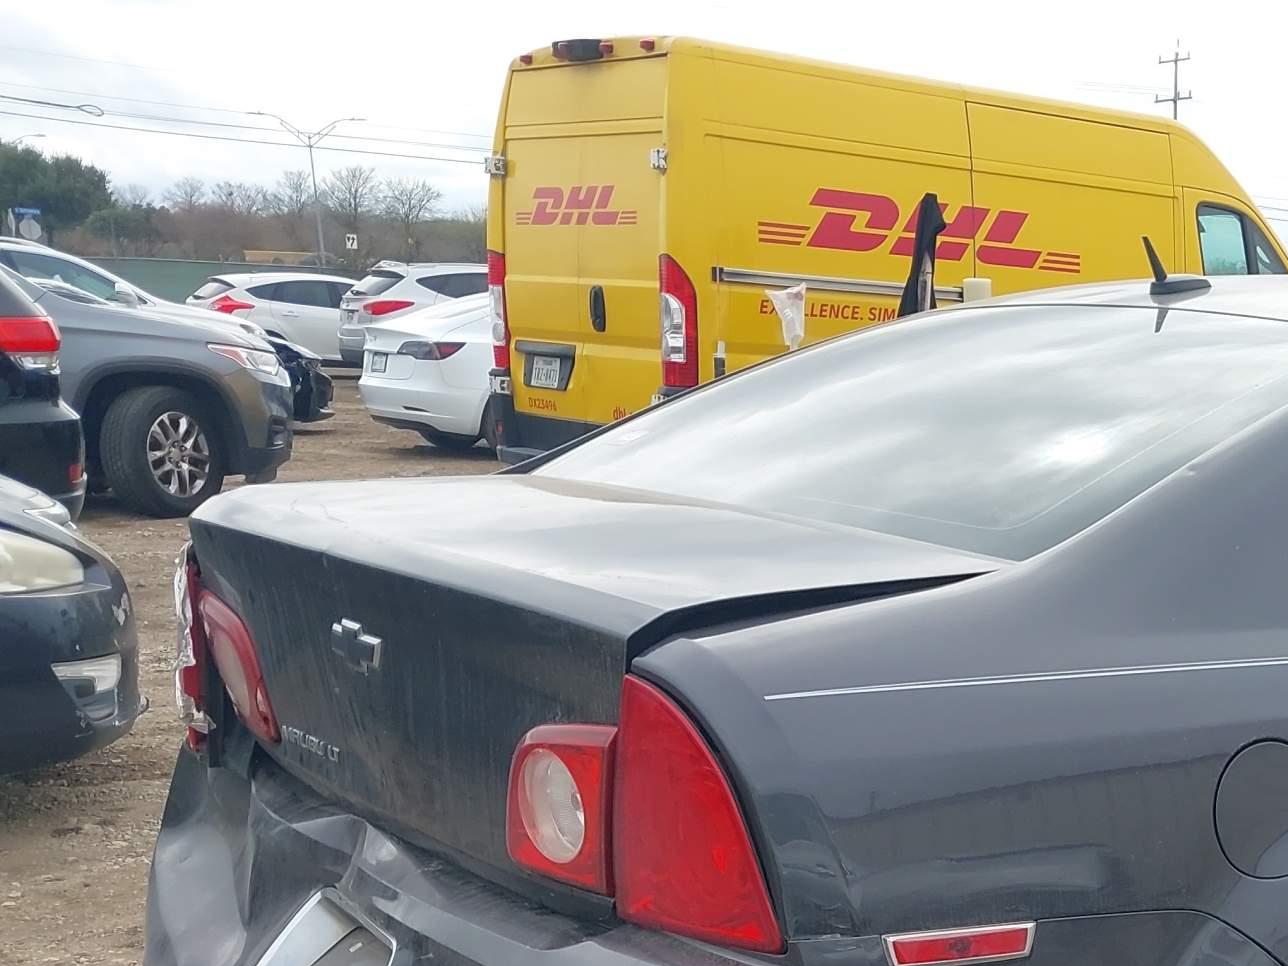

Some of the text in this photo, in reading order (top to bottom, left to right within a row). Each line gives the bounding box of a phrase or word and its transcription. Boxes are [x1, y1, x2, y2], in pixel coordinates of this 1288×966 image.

[530, 185, 620, 225] DHL
[806, 187, 1043, 269] DHL
[759, 299, 864, 321] EXLENCE.
